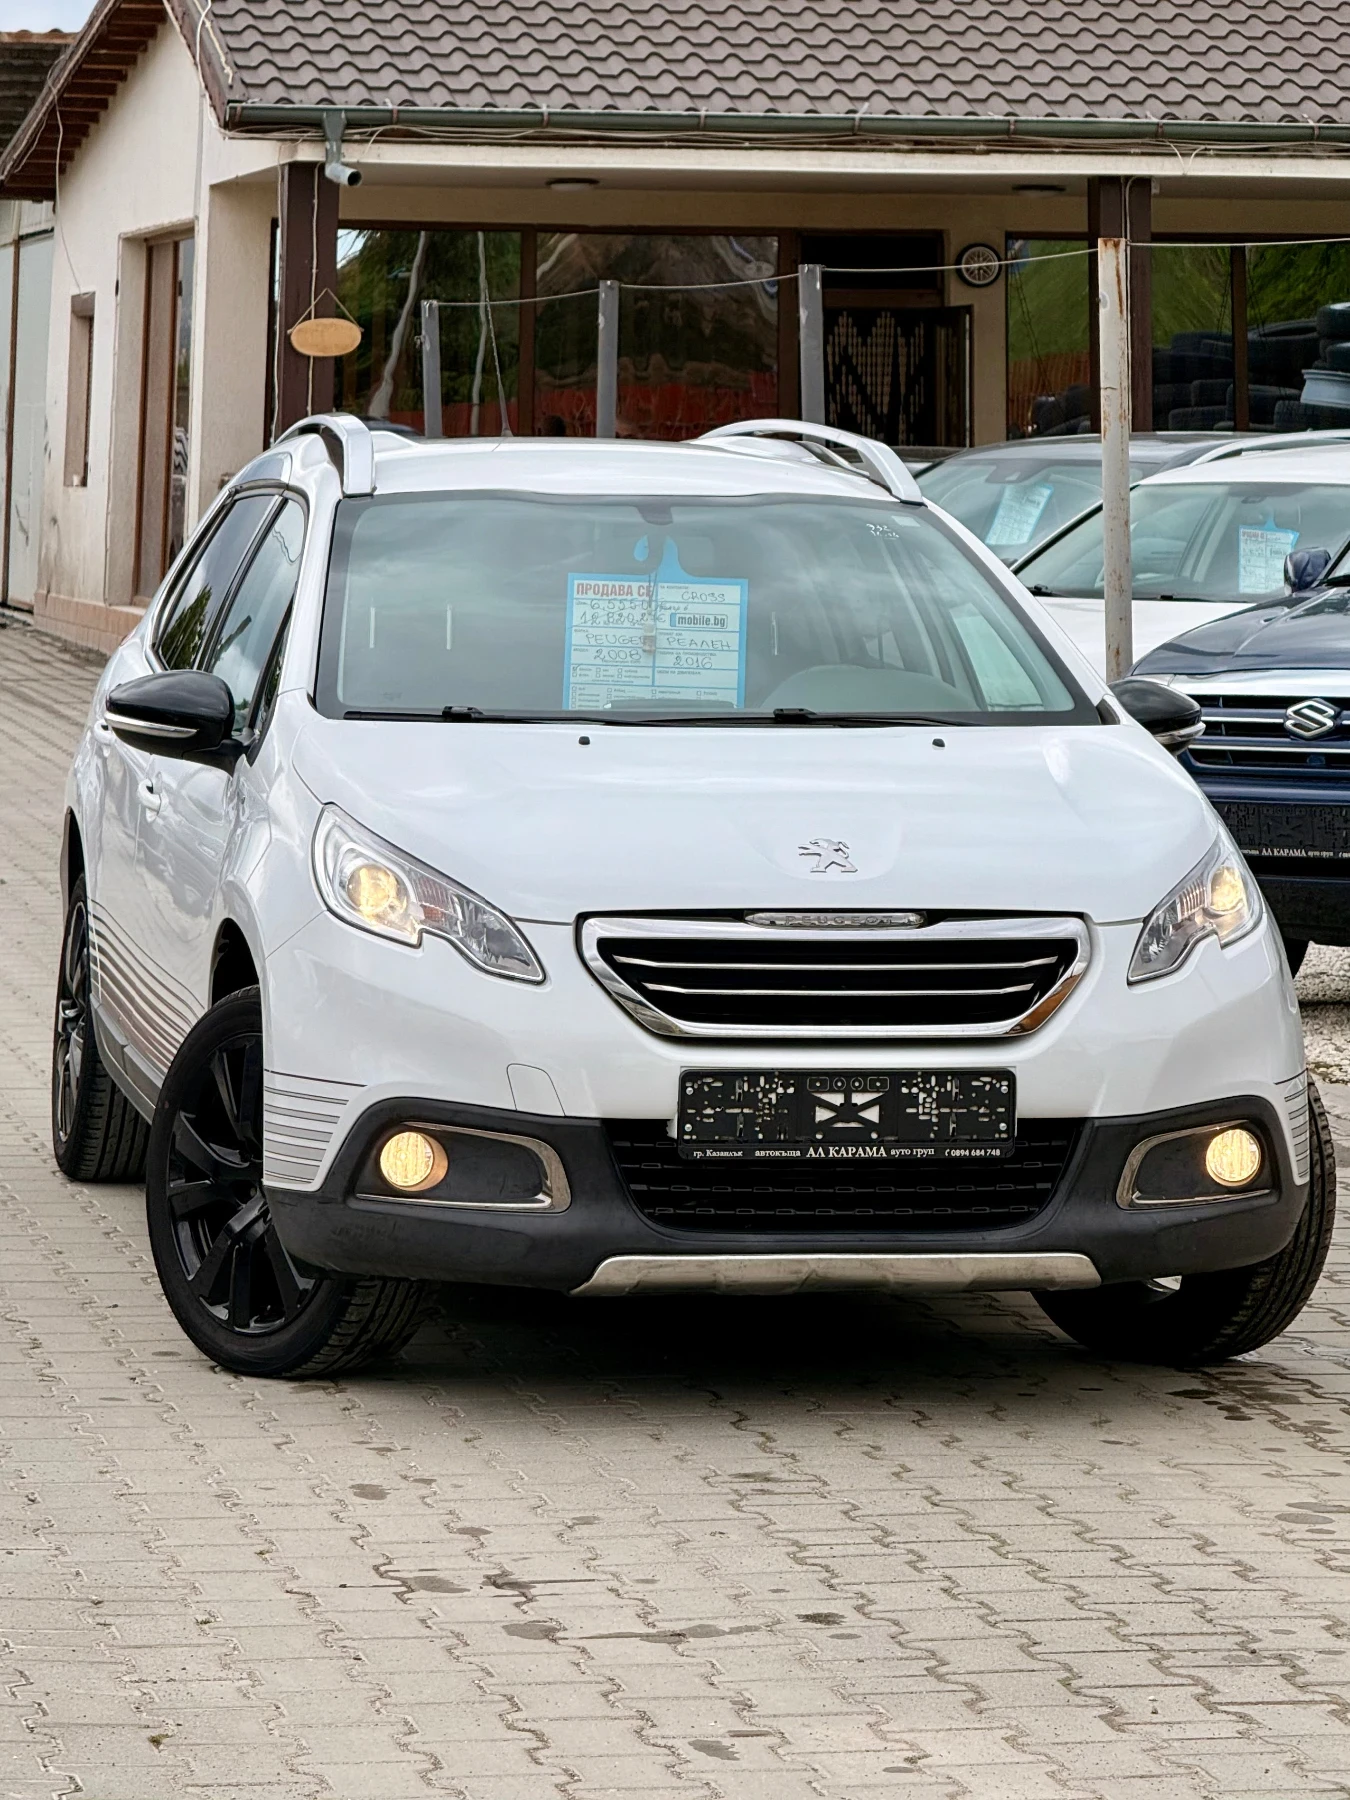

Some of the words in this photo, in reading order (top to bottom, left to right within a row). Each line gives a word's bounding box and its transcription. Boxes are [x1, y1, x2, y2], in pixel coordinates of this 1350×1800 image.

[576, 582, 633, 597] ПРОДАВА
[638, 584, 653, 598] СЕ
[677, 615, 726, 628] mobile.bg
[667, 637, 732, 650] РЕАЛЕН
[594, 648, 642, 660] 2008
[673, 655, 713, 669] 2016
[785, 915, 893, 925] PEUGEOT
[755, 1149, 801, 1159] автокъща
[806, 1146, 827, 1158] АЛ
[828, 1146, 888, 1158] КАРАМА
[890, 1149, 911, 1158] ауто
[913, 1148, 935, 1159] груп
[951, 1149, 970, 1157] 0894
[971, 1149, 985, 1157] 684
[986, 1149, 1001, 1157] 748
